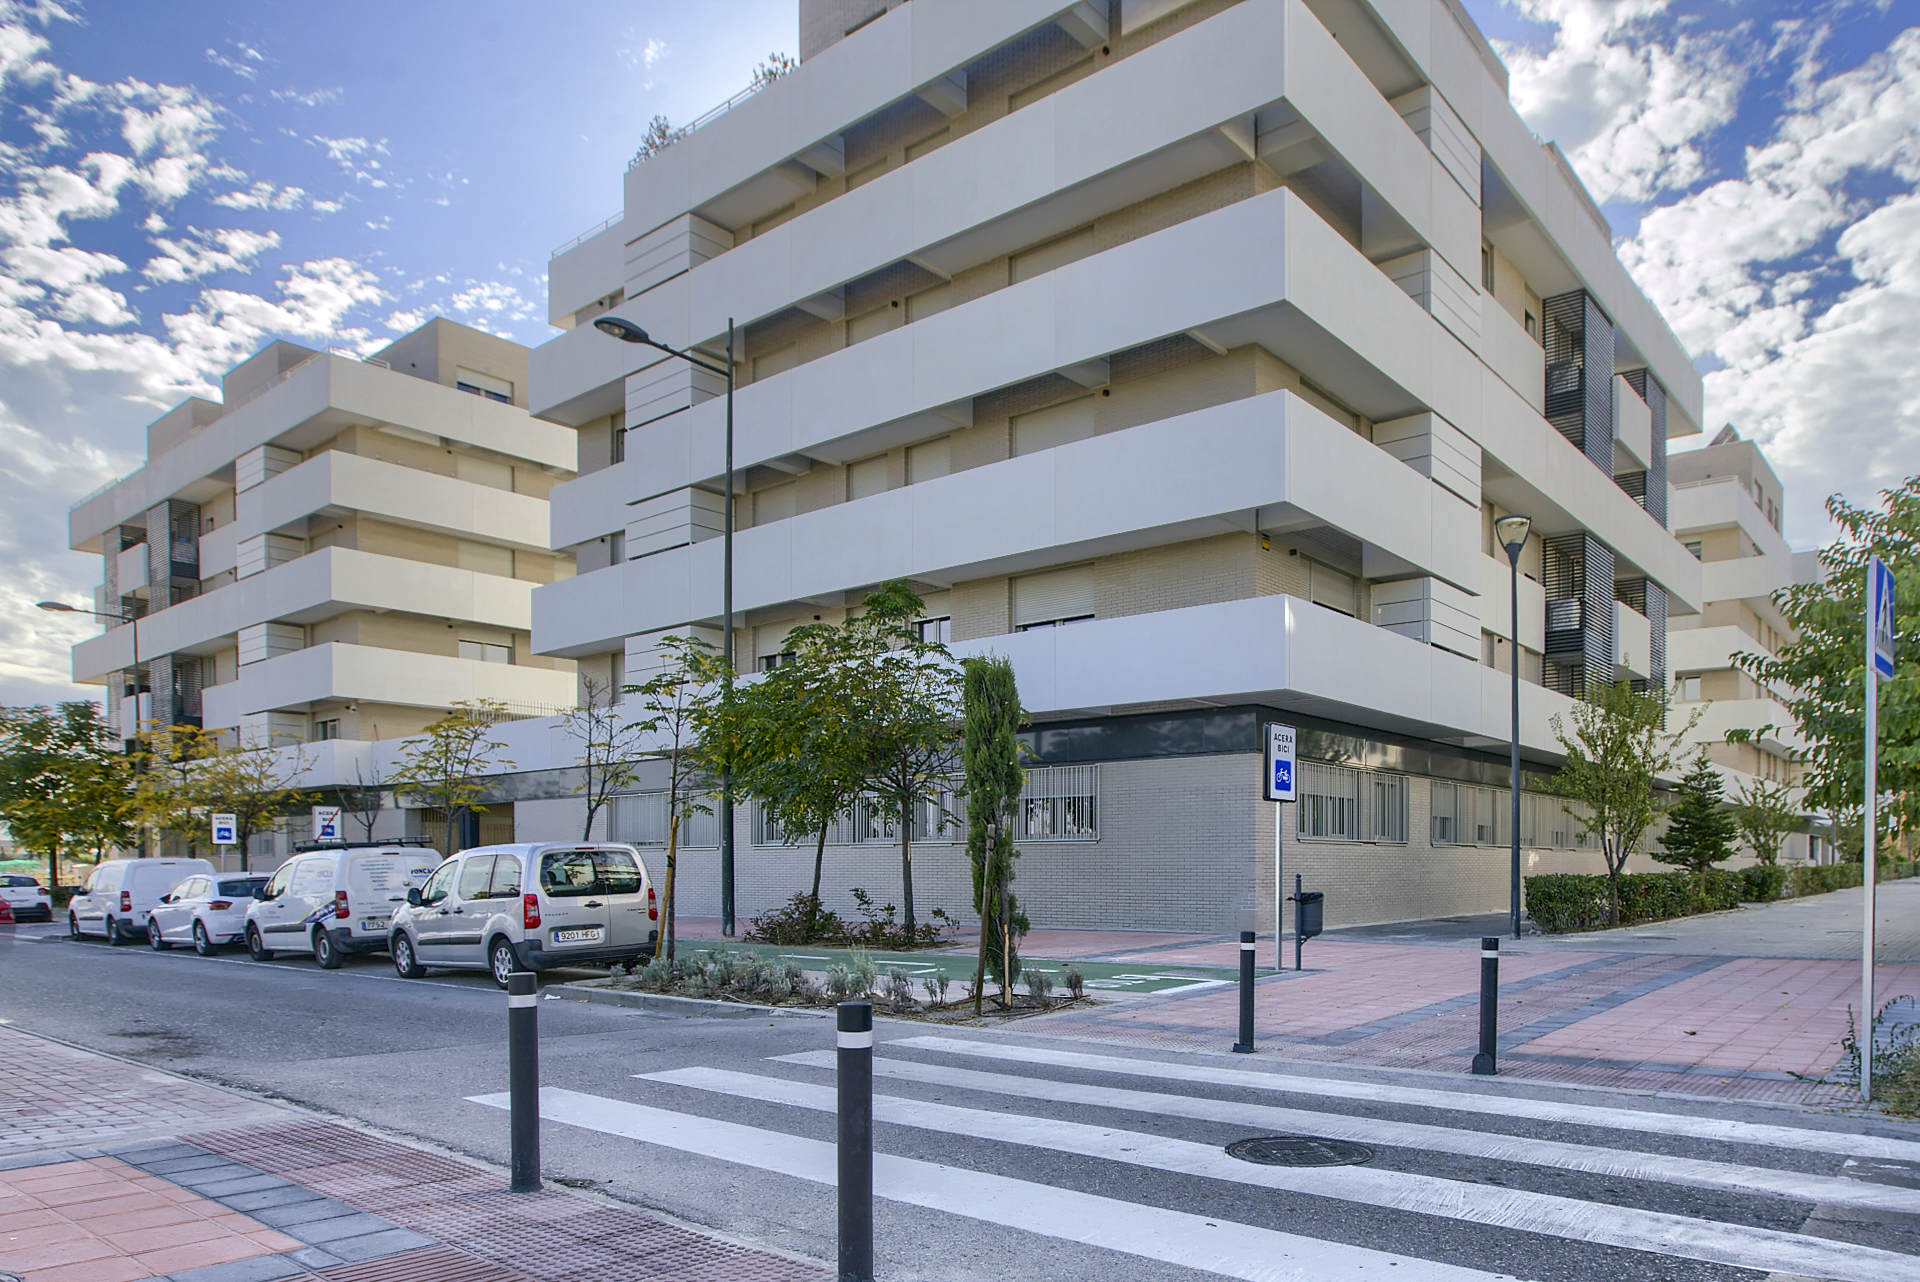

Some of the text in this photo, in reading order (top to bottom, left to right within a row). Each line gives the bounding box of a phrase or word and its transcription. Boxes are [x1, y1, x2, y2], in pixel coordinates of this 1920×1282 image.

[1274, 733, 1293, 743] ACERA
[1277, 744, 1290, 753] BICI
[561, 930, 596, 940] 9201 HFG
